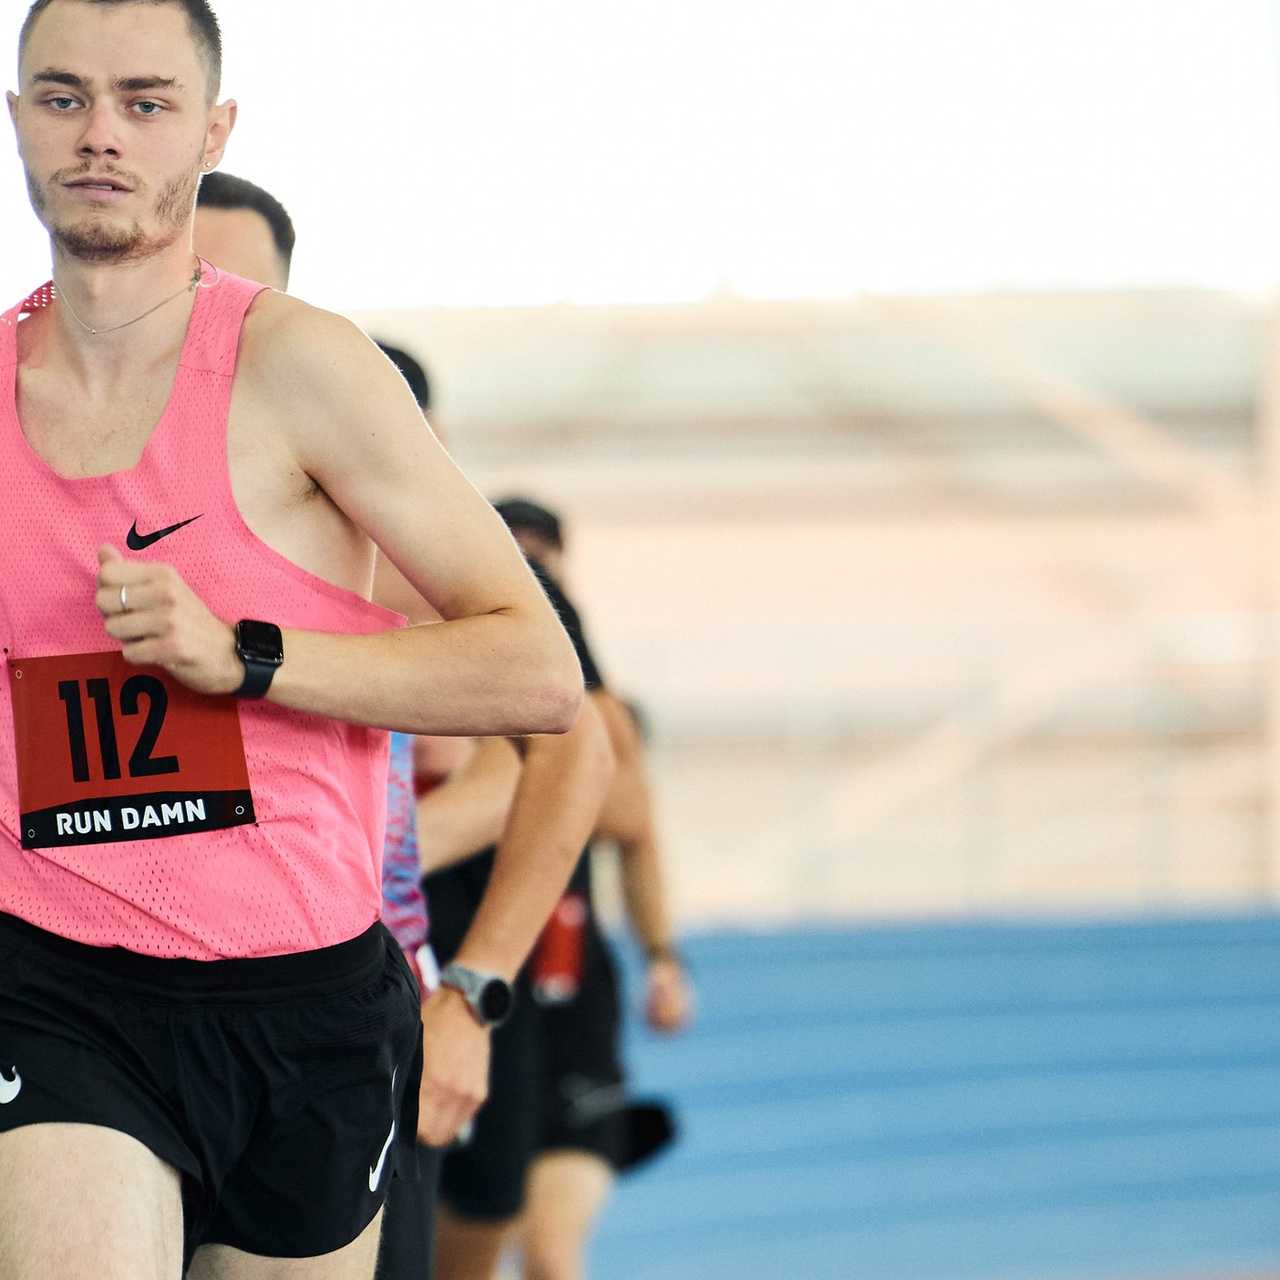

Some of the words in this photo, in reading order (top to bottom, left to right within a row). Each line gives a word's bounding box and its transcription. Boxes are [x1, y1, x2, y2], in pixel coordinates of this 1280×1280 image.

[58, 675, 179, 783] 112
[56, 810, 112, 836] RUN
[121, 798, 206, 830] DAMN
